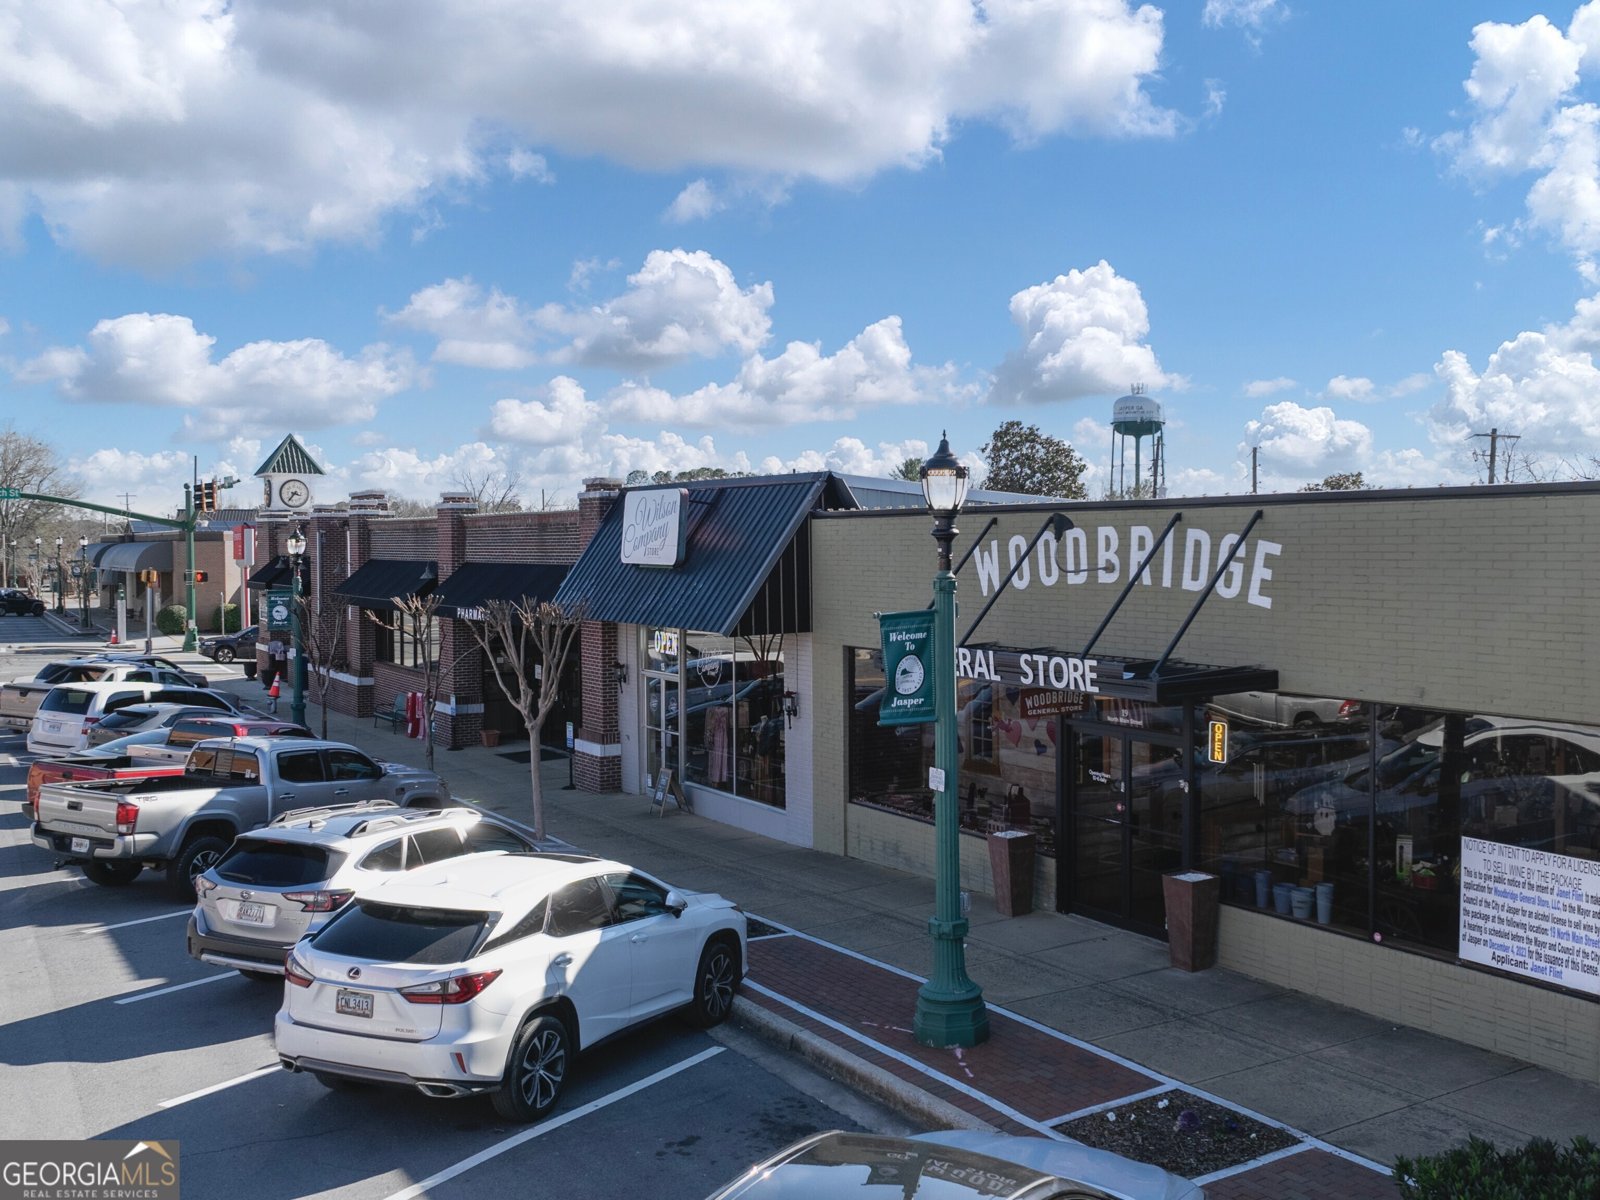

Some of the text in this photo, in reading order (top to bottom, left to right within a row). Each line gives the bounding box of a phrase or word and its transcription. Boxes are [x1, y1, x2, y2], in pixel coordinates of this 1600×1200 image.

[635, 495, 678, 531] Wilson
[623, 523, 669, 559] Company
[973, 526, 1283, 609] WOODBRIDGE
[654, 630, 679, 656] OPEN
[889, 632, 927, 642] Welcome
[904, 642, 915, 651] To
[1020, 653, 1099, 693] STORE
[891, 697, 925, 708] Jasper
[1025, 691, 1084, 710] WOODBRIDGE
[1028, 705, 1084, 716] GENERAL STORE
[1215, 724, 1223, 761] OPEN
[1463, 838, 1486, 853] NOTICE
[1488, 843, 1496, 855] OF
[1497, 845, 1520, 860] INTENT
[1521, 849, 1530, 862] TO
[1530, 851, 1551, 866] APPLY
[1552, 855, 1567, 869] FOR
[1463, 866, 1473, 878] This
[1493, 874, 1507, 886] public
[1507, 877, 1521, 889] notice
[1535, 883, 1549, 895] intent
[1556, 887, 1571, 900] Janet
[1571, 889, 1584, 902] Flint
[1483, 858, 1583, 891] TO SELL WINE BY THE PACKAGE
[1462, 893, 1478, 906] Council
[1491, 900, 1500, 913] City
[1506, 903, 1520, 917] Jasper
[1534, 910, 1551, 923] alcohol
[1550, 913, 1567, 928] license
[1463, 881, 1487, 894] application
[1493, 886, 1519, 903] Woodbridge
[1519, 891, 1537, 906] General
[1576, 904, 1591, 919] Mayor
[1467, 920, 1483, 936] hearing
[1488, 926, 1510, 941] scheduled
[1510, 930, 1525, 944] before
[1533, 936, 1548, 951] Mayor
[1557, 942, 1575, 957] Council
[1471, 910, 1490, 924] package
[1505, 916, 1527, 934] following
[1556, 927, 1571, 942] North
[1571, 931, 1584, 945] Main
[1467, 932, 1482, 947] Jasper
[1488, 938, 1511, 954] December
[1543, 950, 1564, 968] issuance
[1491, 951, 1563, 980] Applicant: Janet Flint
